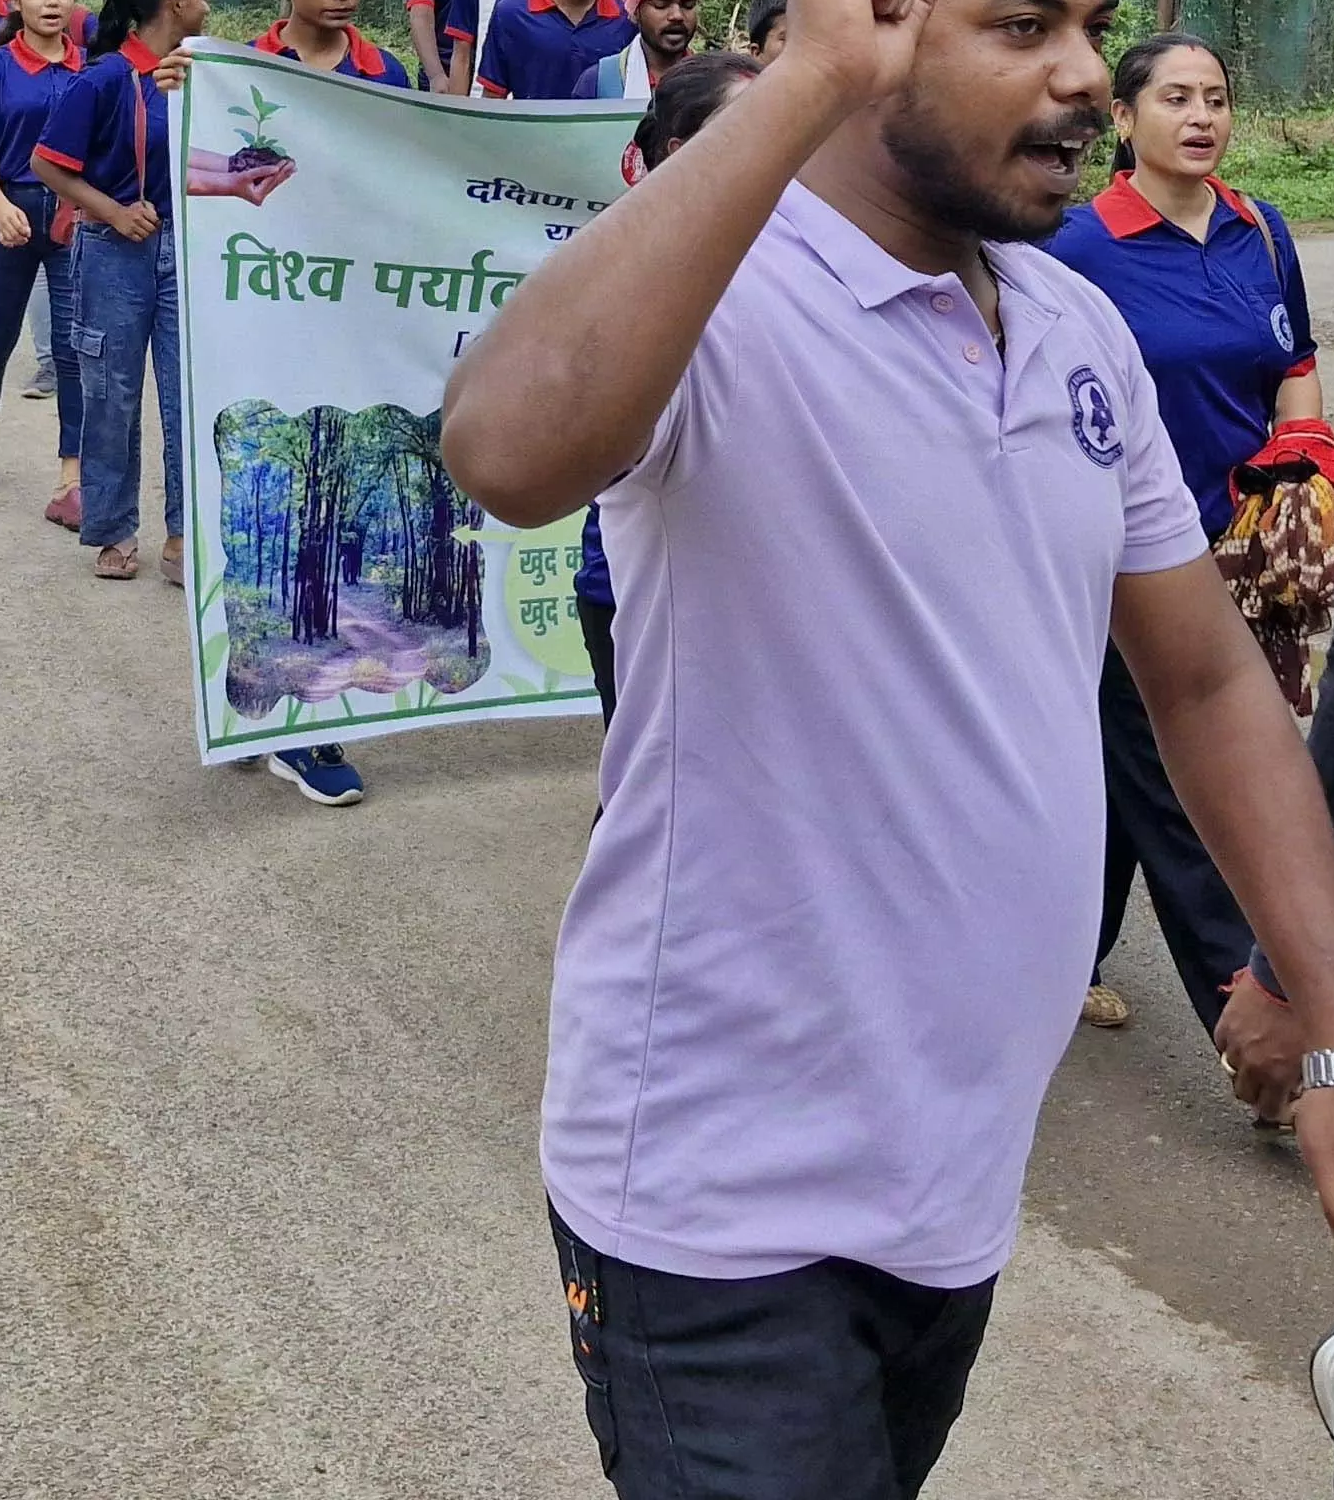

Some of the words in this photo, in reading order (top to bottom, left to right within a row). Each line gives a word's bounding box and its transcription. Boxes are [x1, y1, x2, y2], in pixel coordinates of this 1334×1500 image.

[466, 177, 579, 211] दक्षिण
[220, 232, 355, 301] विश्व
[519, 547, 558, 586] खुद
[519, 597, 559, 636] खुद
